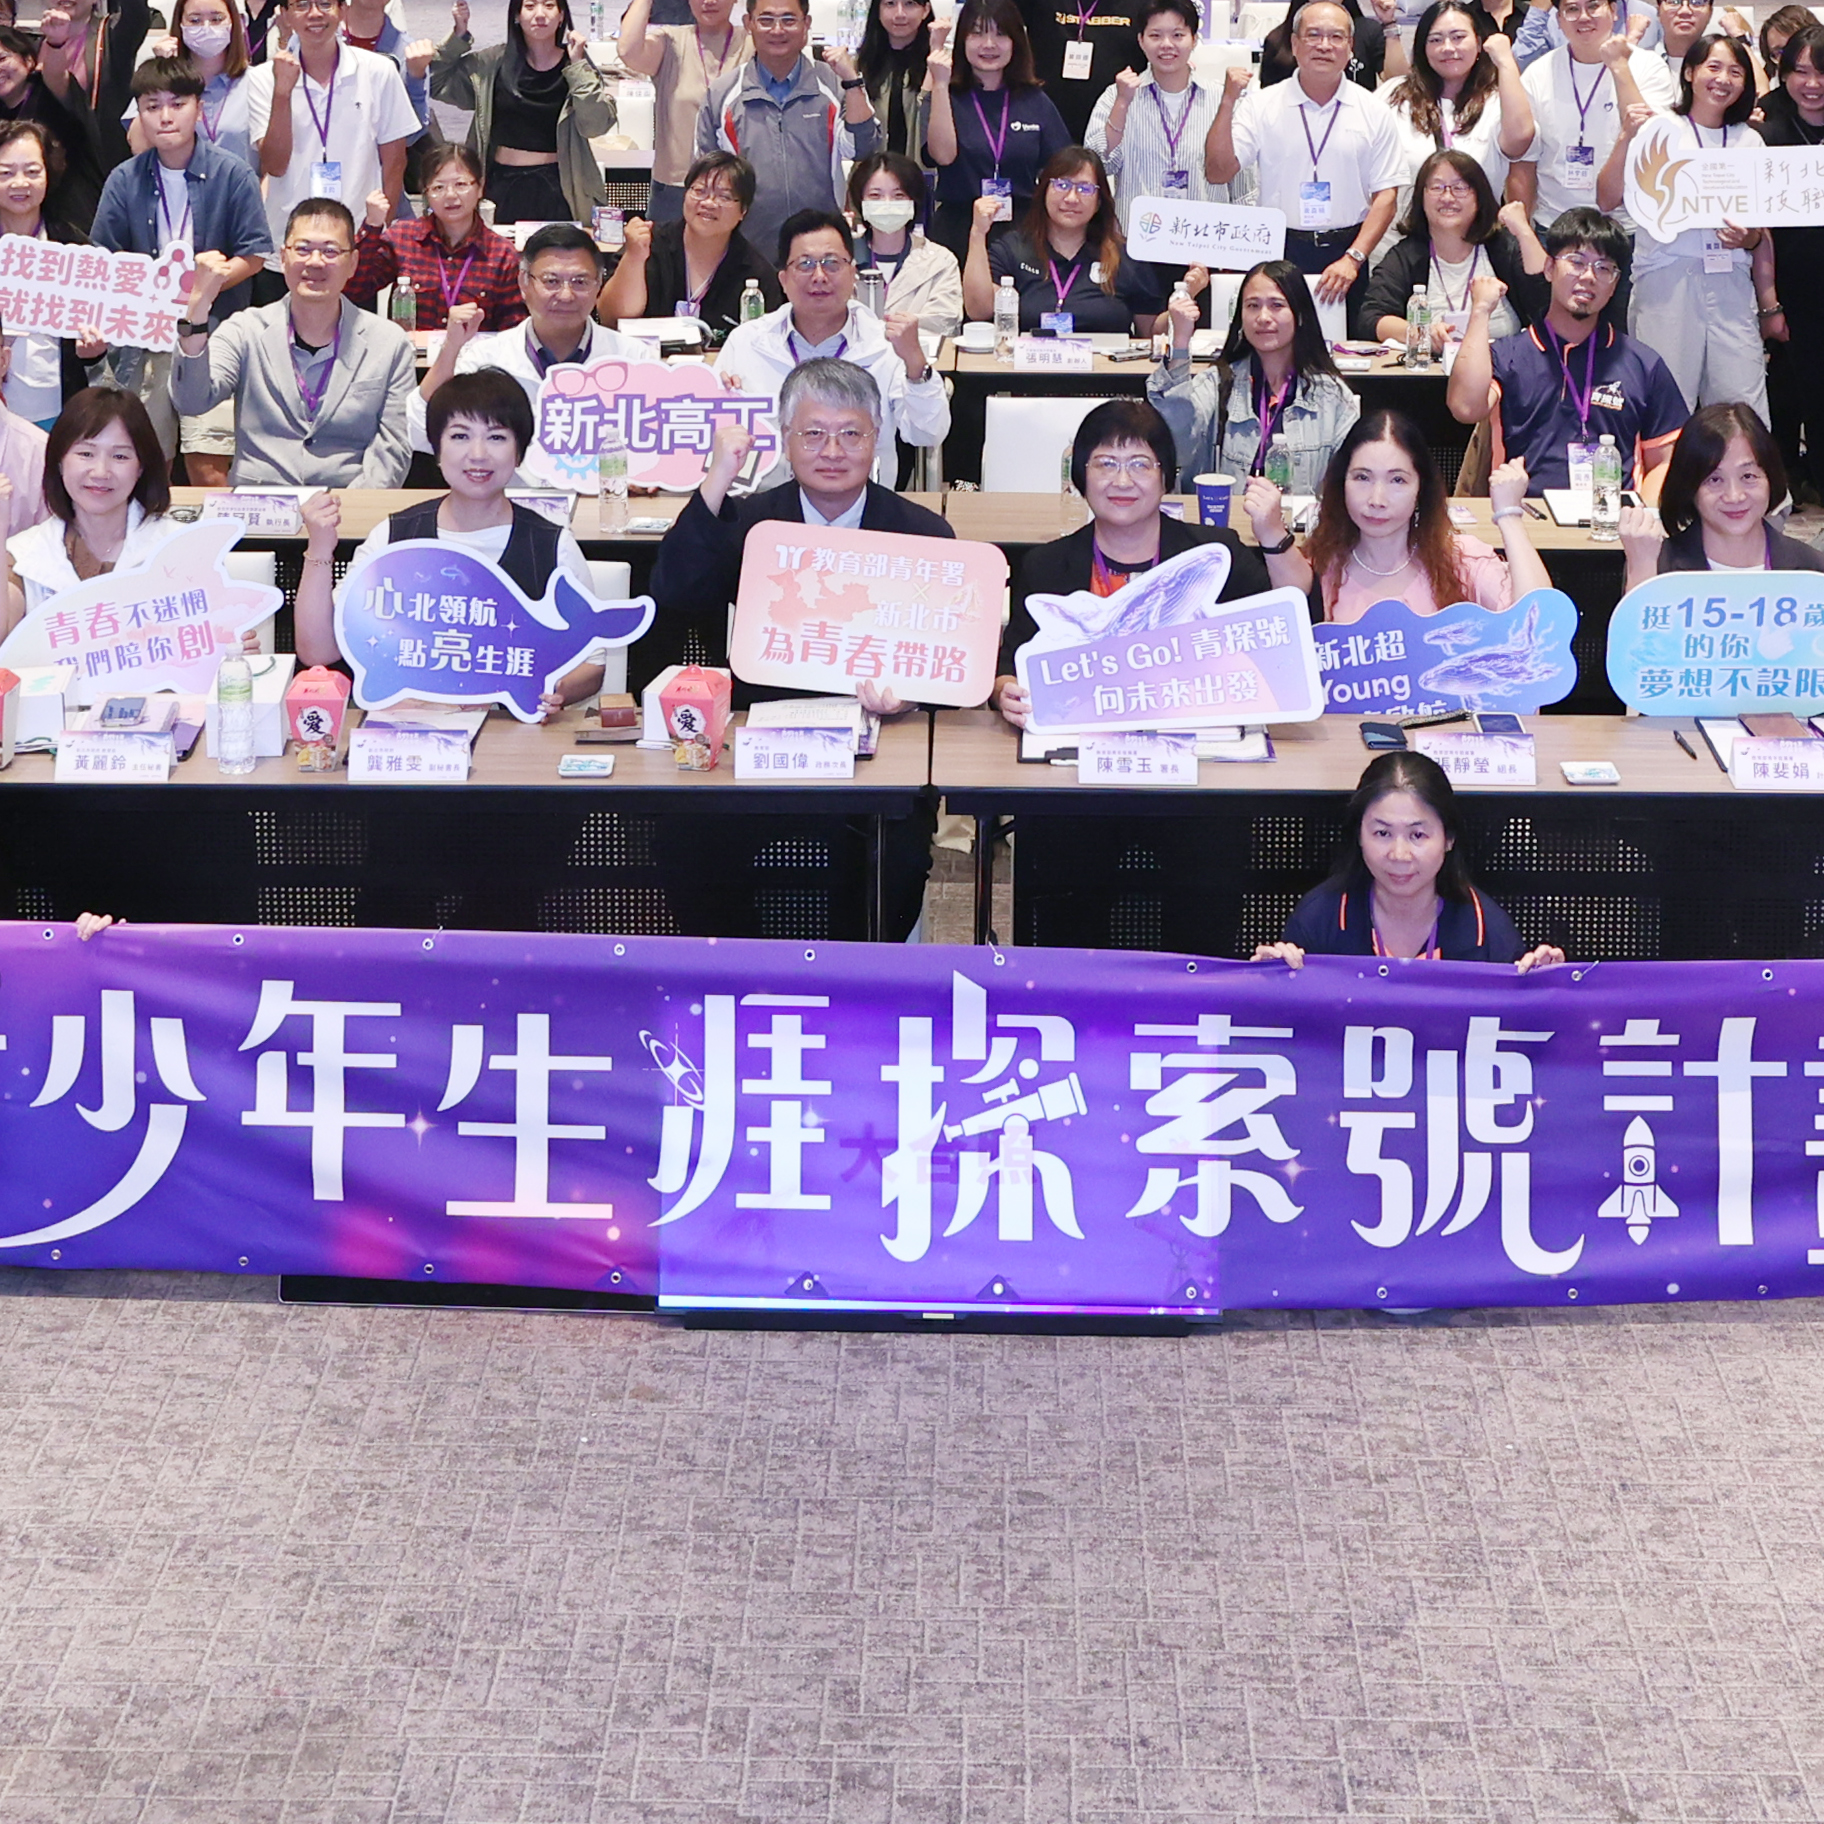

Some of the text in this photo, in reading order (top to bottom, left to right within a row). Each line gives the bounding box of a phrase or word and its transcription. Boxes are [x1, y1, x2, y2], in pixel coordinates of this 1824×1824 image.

[1681, 195, 1749, 214] NTVE
[1168, 218, 1272, 246] 新北市政府
[1170, 240, 1273, 256] New Taipei City Government
[0, 240, 145, 298] 找到熱愛
[542, 398, 778, 457] 新北高工
[812, 544, 966, 588] 教育部青年署
[365, 577, 498, 620] 心北領航
[43, 588, 210, 651] 青春不迷惘
[875, 599, 959, 632] 新北市
[398, 630, 536, 678] 點亮生涯
[758, 622, 967, 684] 為青春帶路
[1039, 616, 1292, 687] Let's Go! 青探號
[1315, 629, 1408, 672] 新北超
[1683, 632, 1750, 659] 的你
[1092, 670, 1259, 717] 向未來出發
[1323, 672, 1411, 705] Young
[302, 710, 326, 734] 愛
[677, 708, 699, 733] 愛
[74, 755, 127, 771] 黃麗鈴
[367, 755, 423, 773] 龔雅雯
[752, 752, 810, 771] 劉國偉
[1097, 757, 1153, 774] 陳雪玉
[1438, 756, 1490, 774] 張靜瑩
